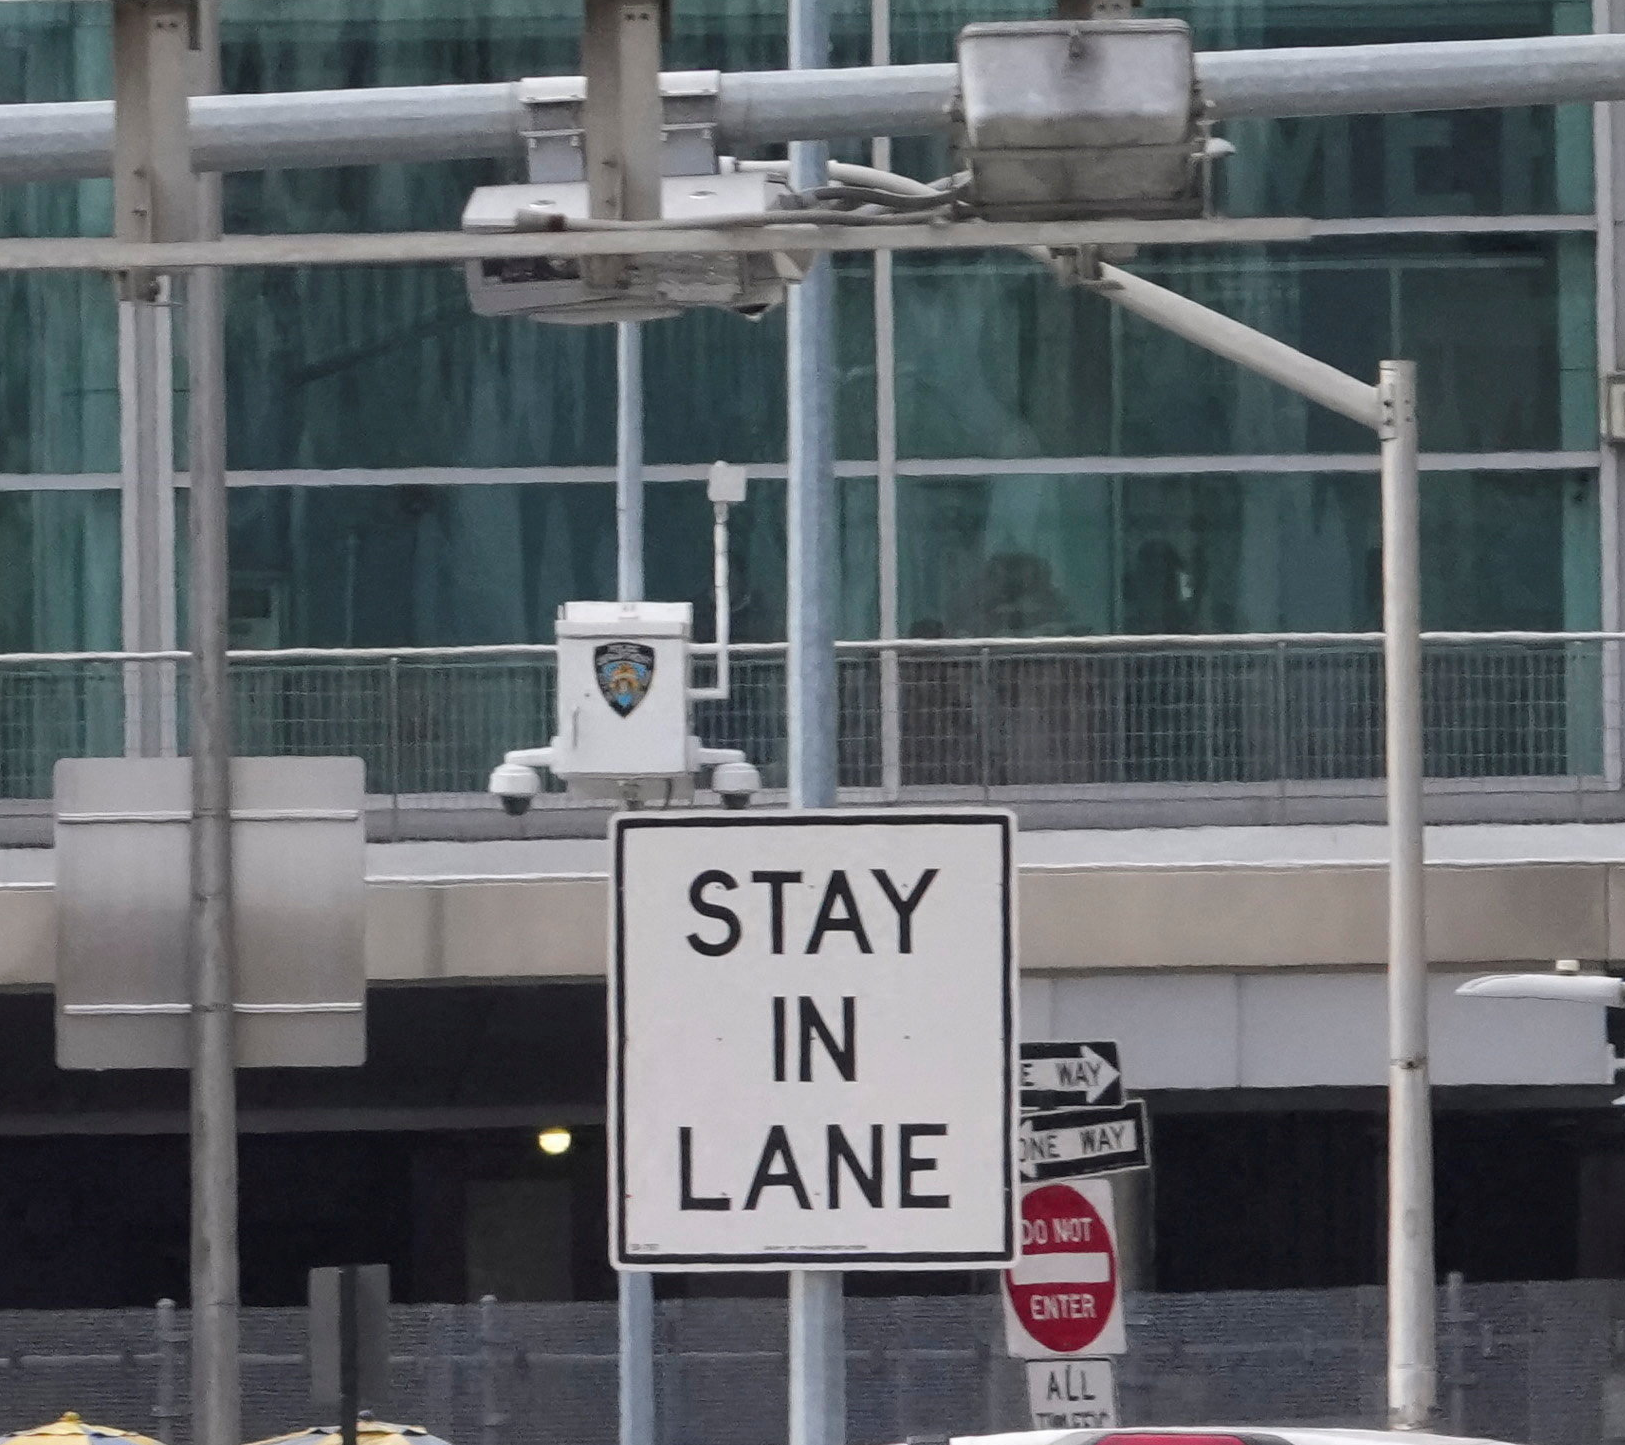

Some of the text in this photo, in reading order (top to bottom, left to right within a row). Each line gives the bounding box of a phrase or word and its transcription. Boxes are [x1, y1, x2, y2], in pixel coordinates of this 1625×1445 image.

[687, 869, 938, 956] STAY
[774, 996, 856, 1082] IN
[1054, 1060, 1101, 1088] WAY
[1079, 1123, 1126, 1157] WAY
[680, 1124, 950, 1211] LANE
[1021, 1217, 1094, 1246] DO NOT
[1029, 1293, 1098, 1321] ENTER
[1046, 1364, 1096, 1401] ALL
